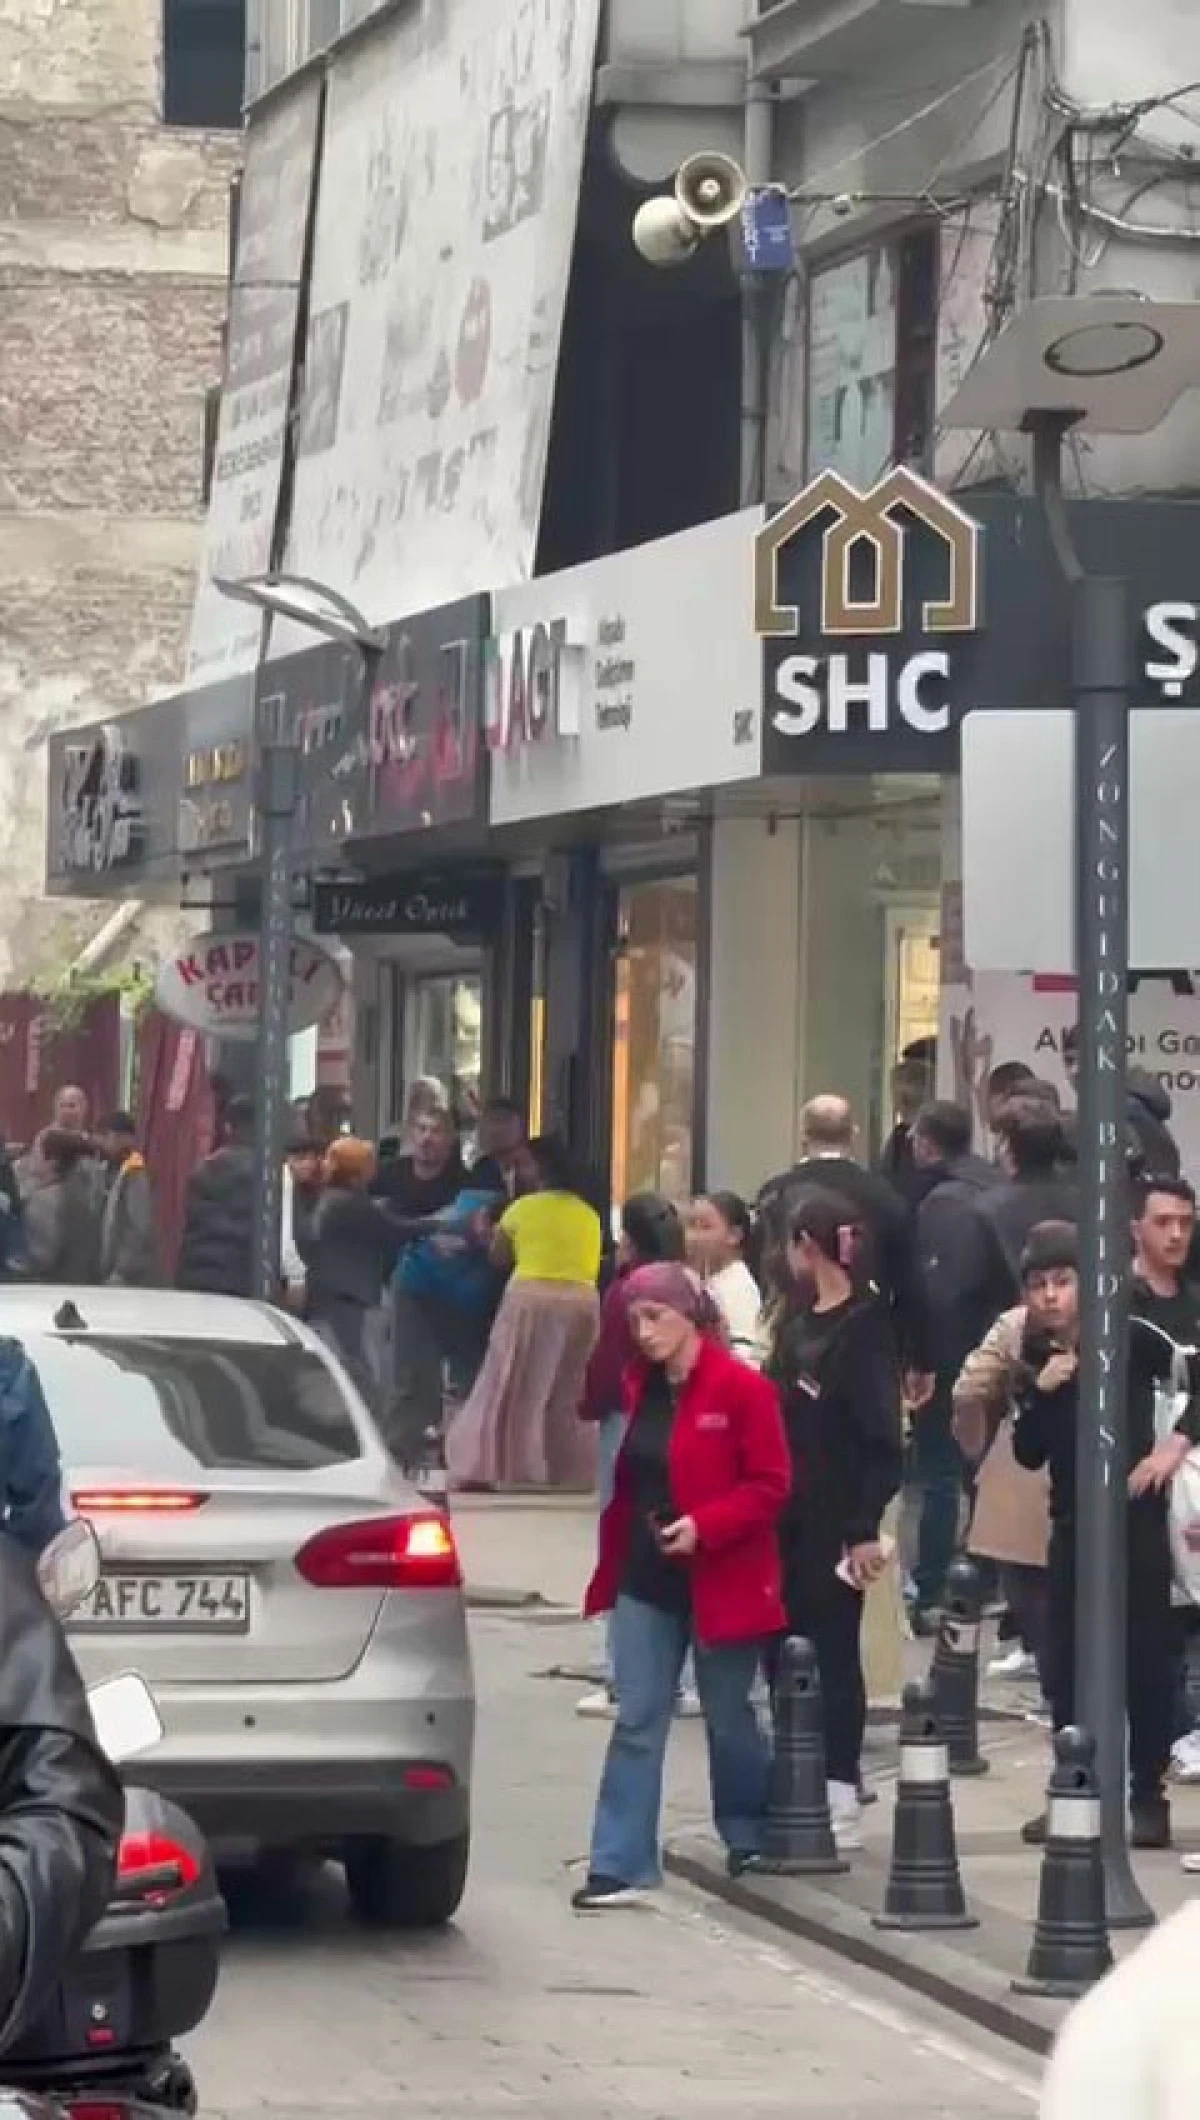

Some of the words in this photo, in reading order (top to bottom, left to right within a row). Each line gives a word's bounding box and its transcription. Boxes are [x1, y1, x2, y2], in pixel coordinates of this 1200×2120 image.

[771, 652, 950, 736] SHC
[174, 940, 320, 986] KAPLI
[92, 1579, 161, 1616] AFC
[175, 1580, 243, 1617] 744
